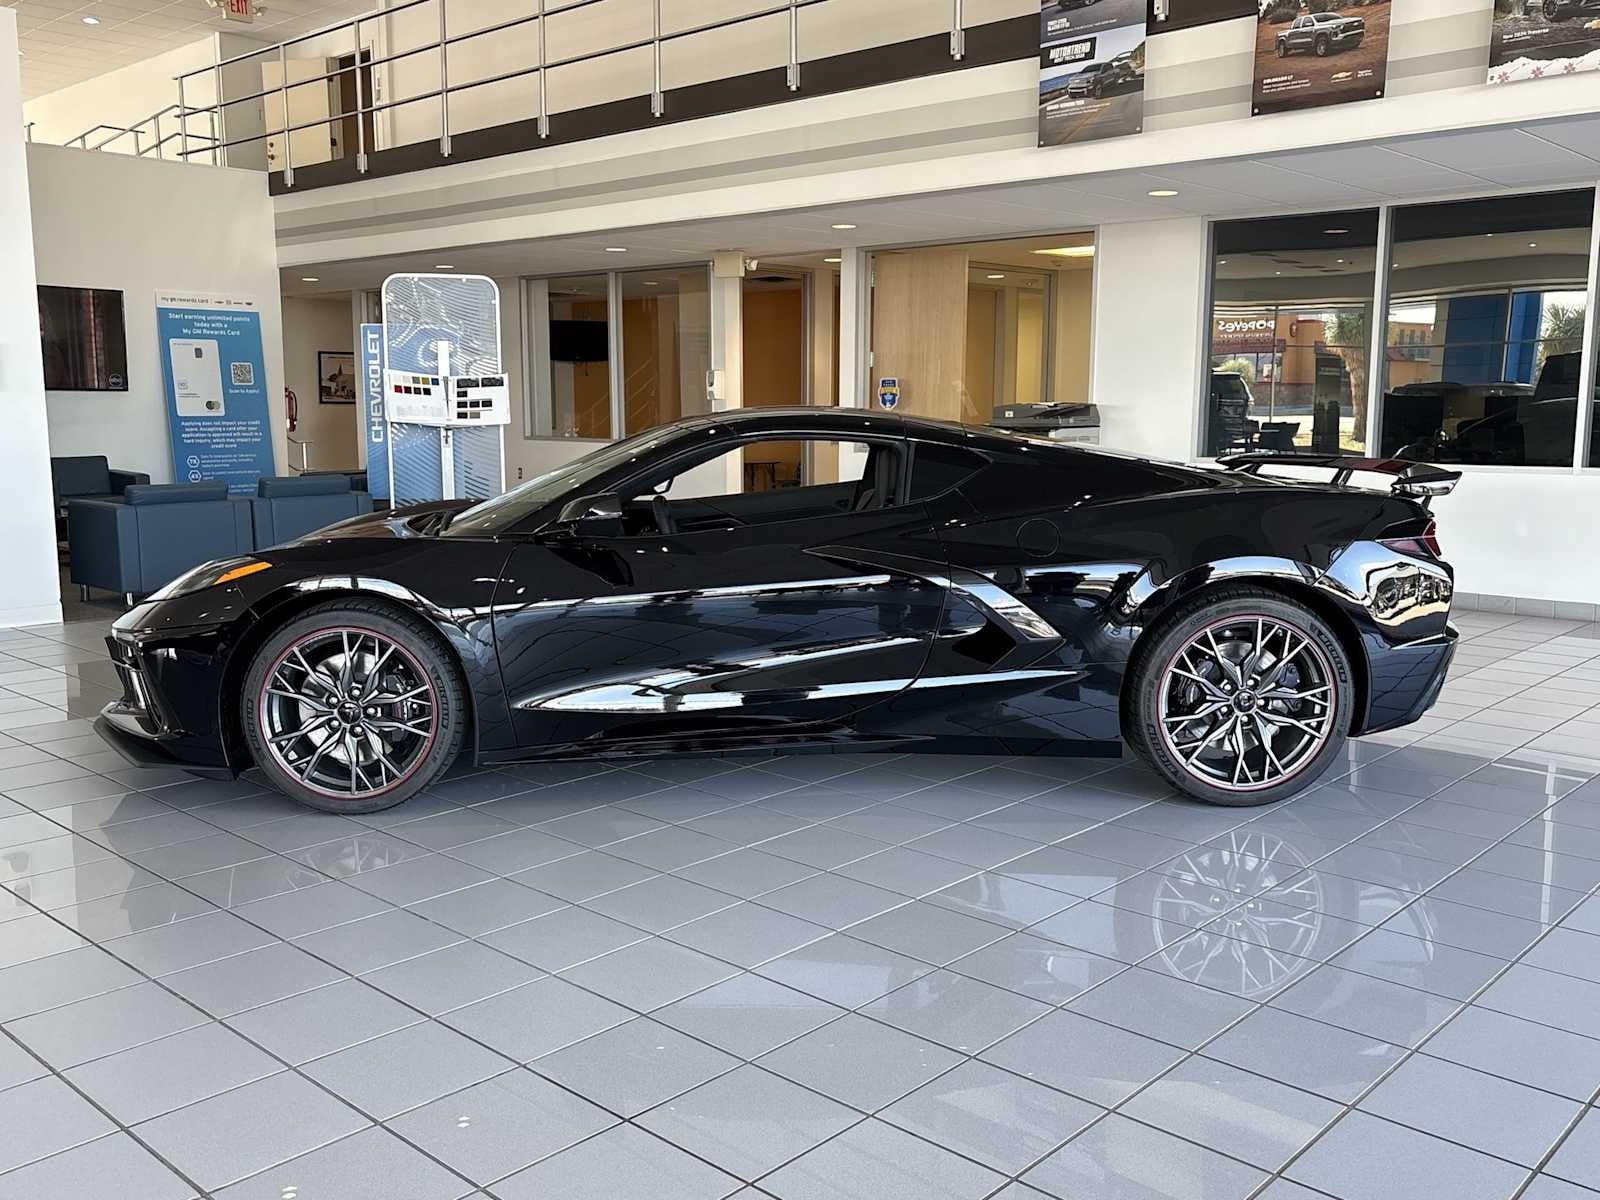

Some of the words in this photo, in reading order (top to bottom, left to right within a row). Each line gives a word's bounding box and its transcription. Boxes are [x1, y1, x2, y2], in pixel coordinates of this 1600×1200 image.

[1049, 41, 1092, 60] MOTORTREND
[367, 331, 384, 442] CHEVROLET
[1318, 631, 1347, 683] MICHELIN
